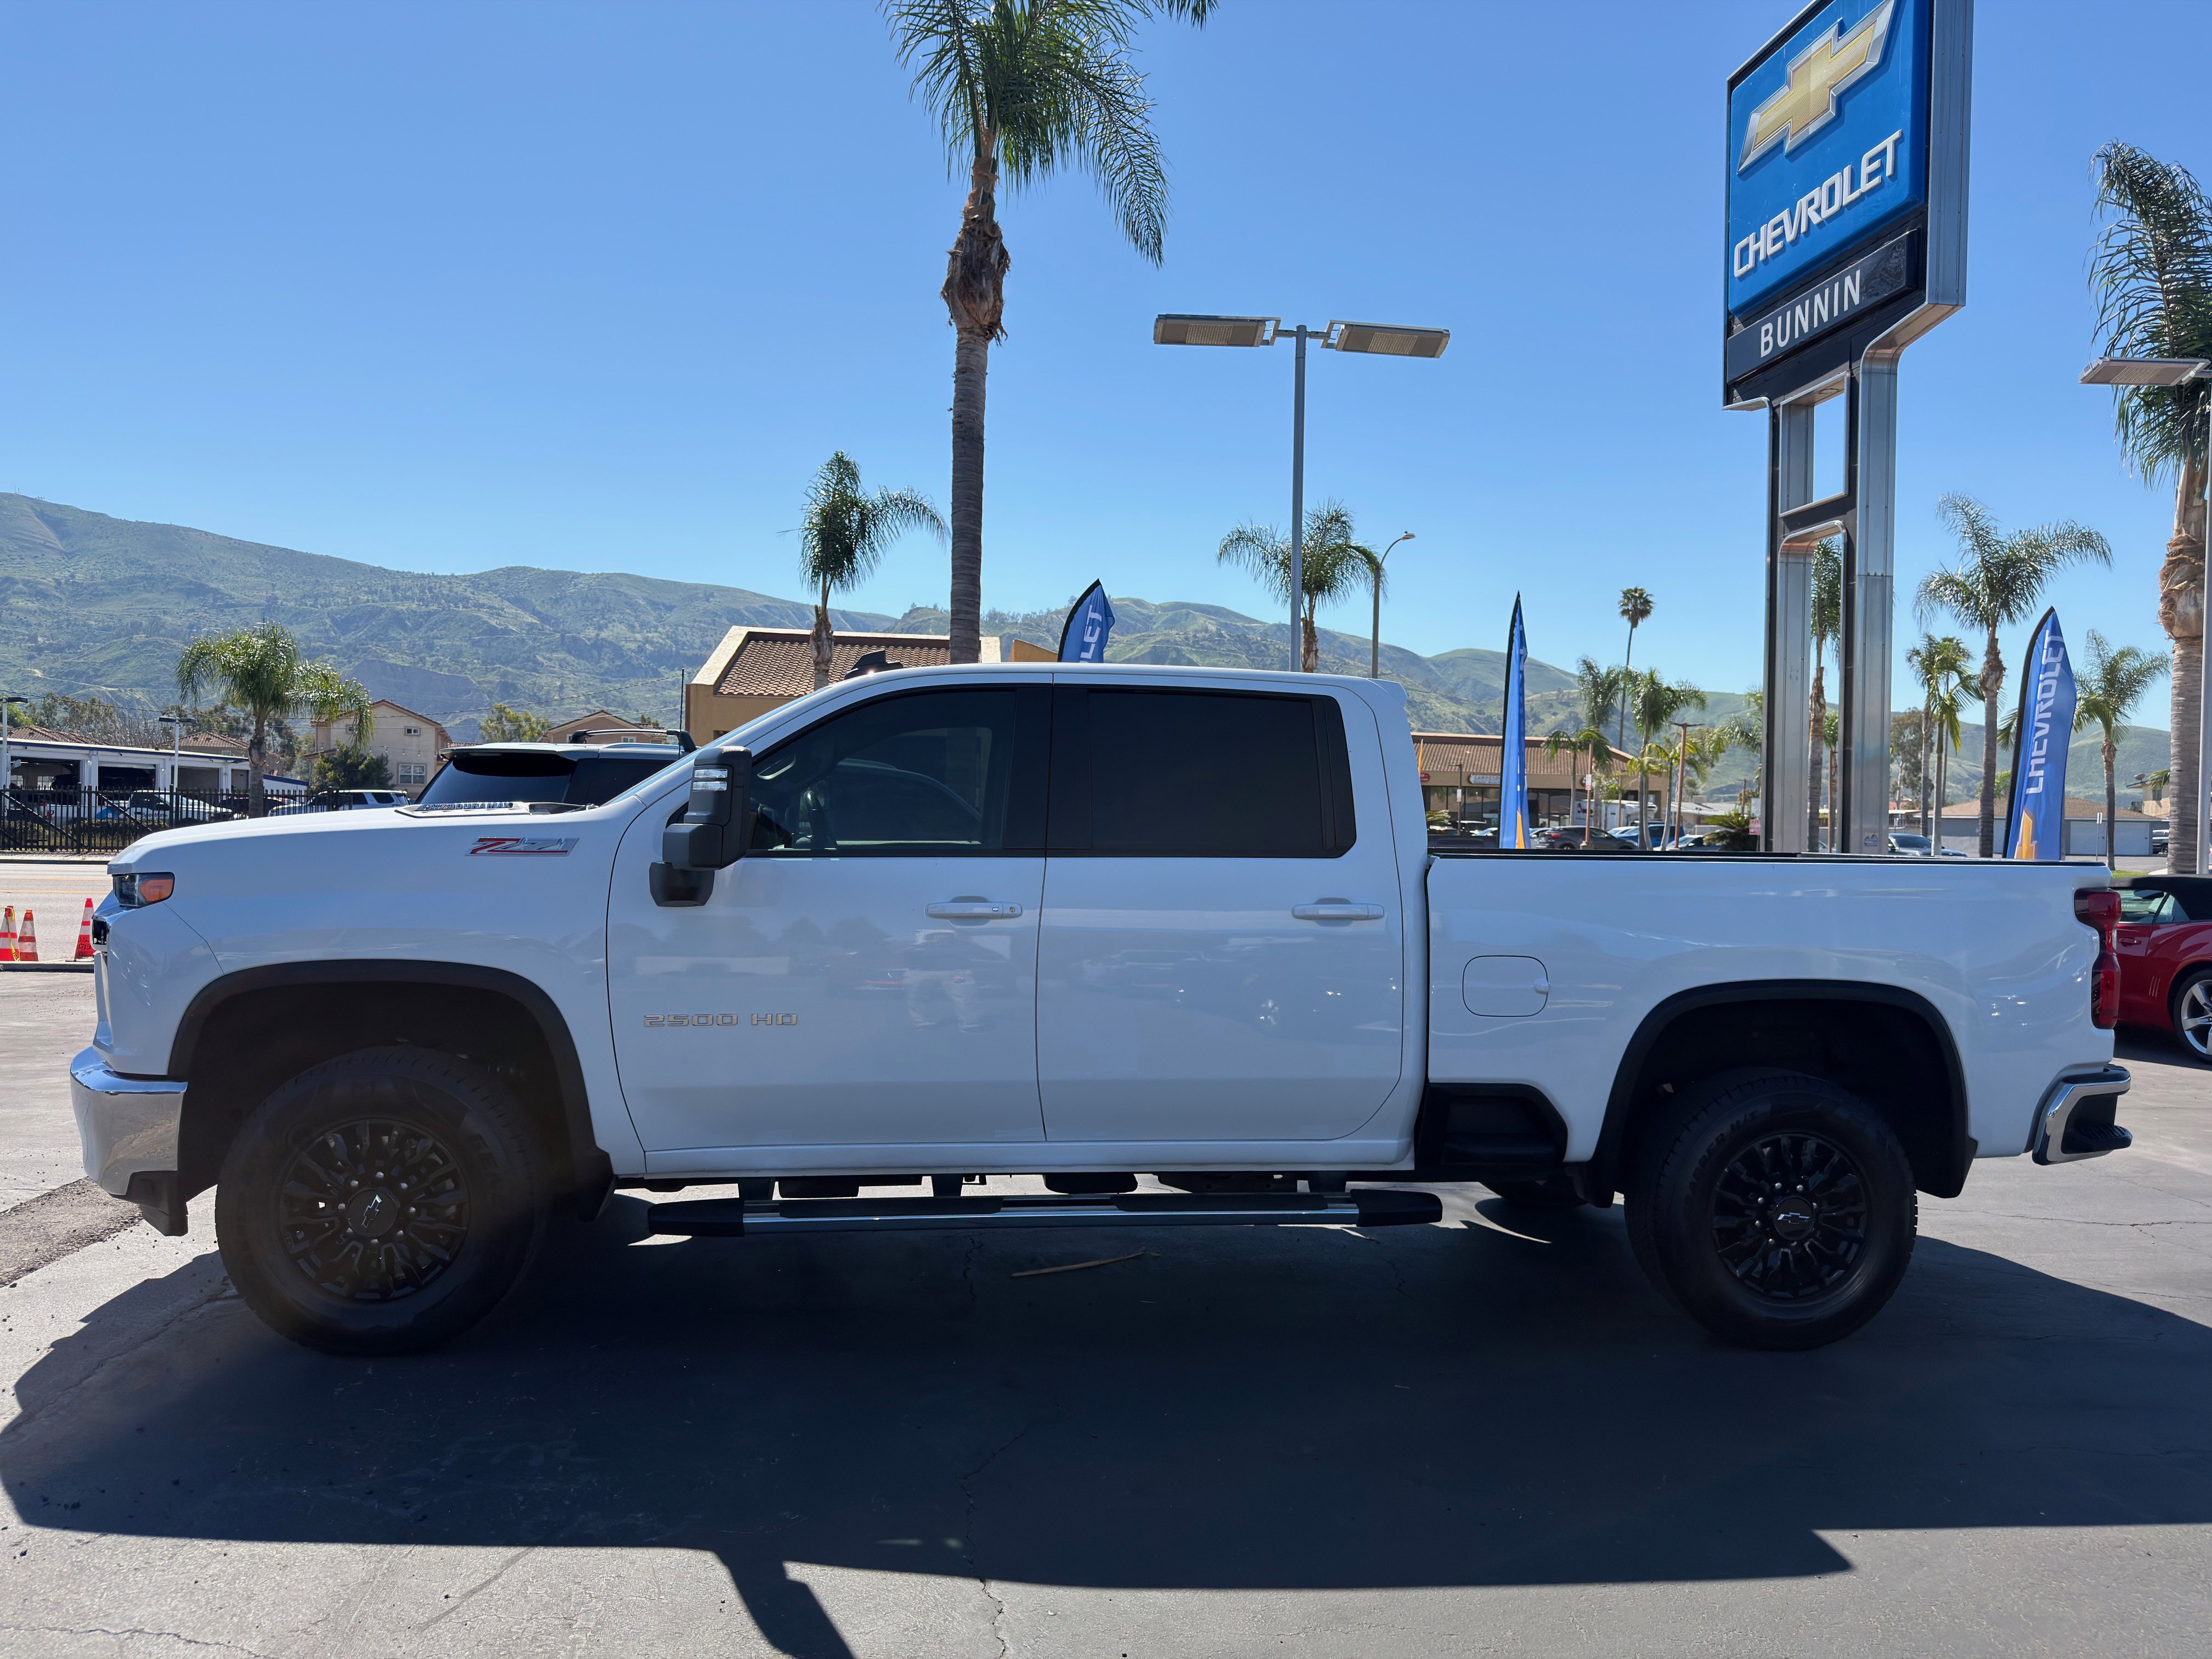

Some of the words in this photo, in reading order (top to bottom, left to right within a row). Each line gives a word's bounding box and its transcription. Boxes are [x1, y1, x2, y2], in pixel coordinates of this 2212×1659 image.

[1733, 129, 1902, 278] CHEVROLET
[1760, 270, 1861, 358] BUNNIN
[464, 837, 580, 857] Z71
[643, 1013, 738, 1027] 2500
[751, 1012, 798, 1026] HD
